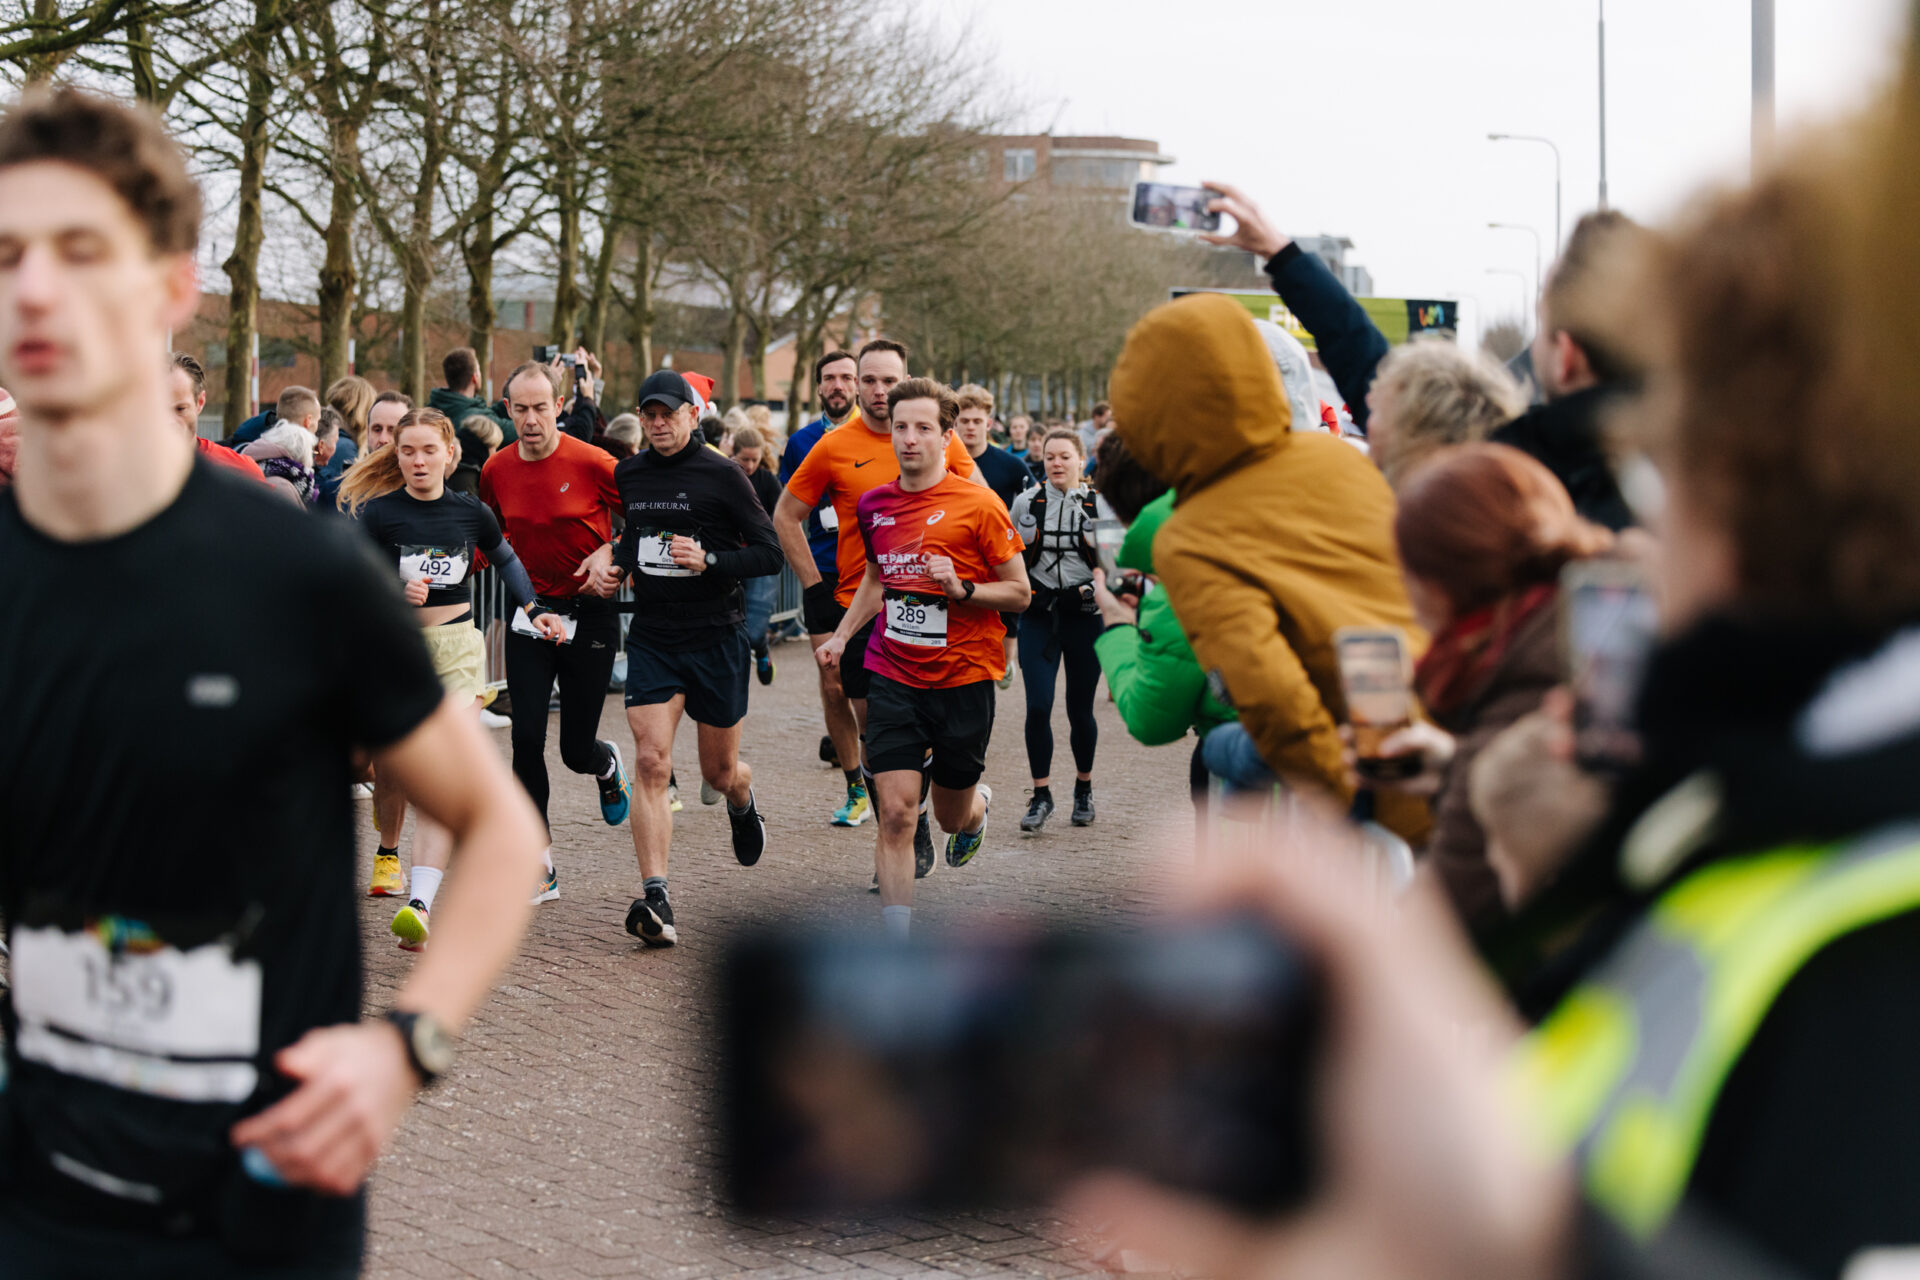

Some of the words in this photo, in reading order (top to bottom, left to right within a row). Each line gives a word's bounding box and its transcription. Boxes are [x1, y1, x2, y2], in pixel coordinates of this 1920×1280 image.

[877, 553, 889, 564] BE
[889, 553, 919, 564] PART
[420, 560, 451, 576] 492
[896, 605, 926, 624] 289
[82, 954, 174, 1021] 159
